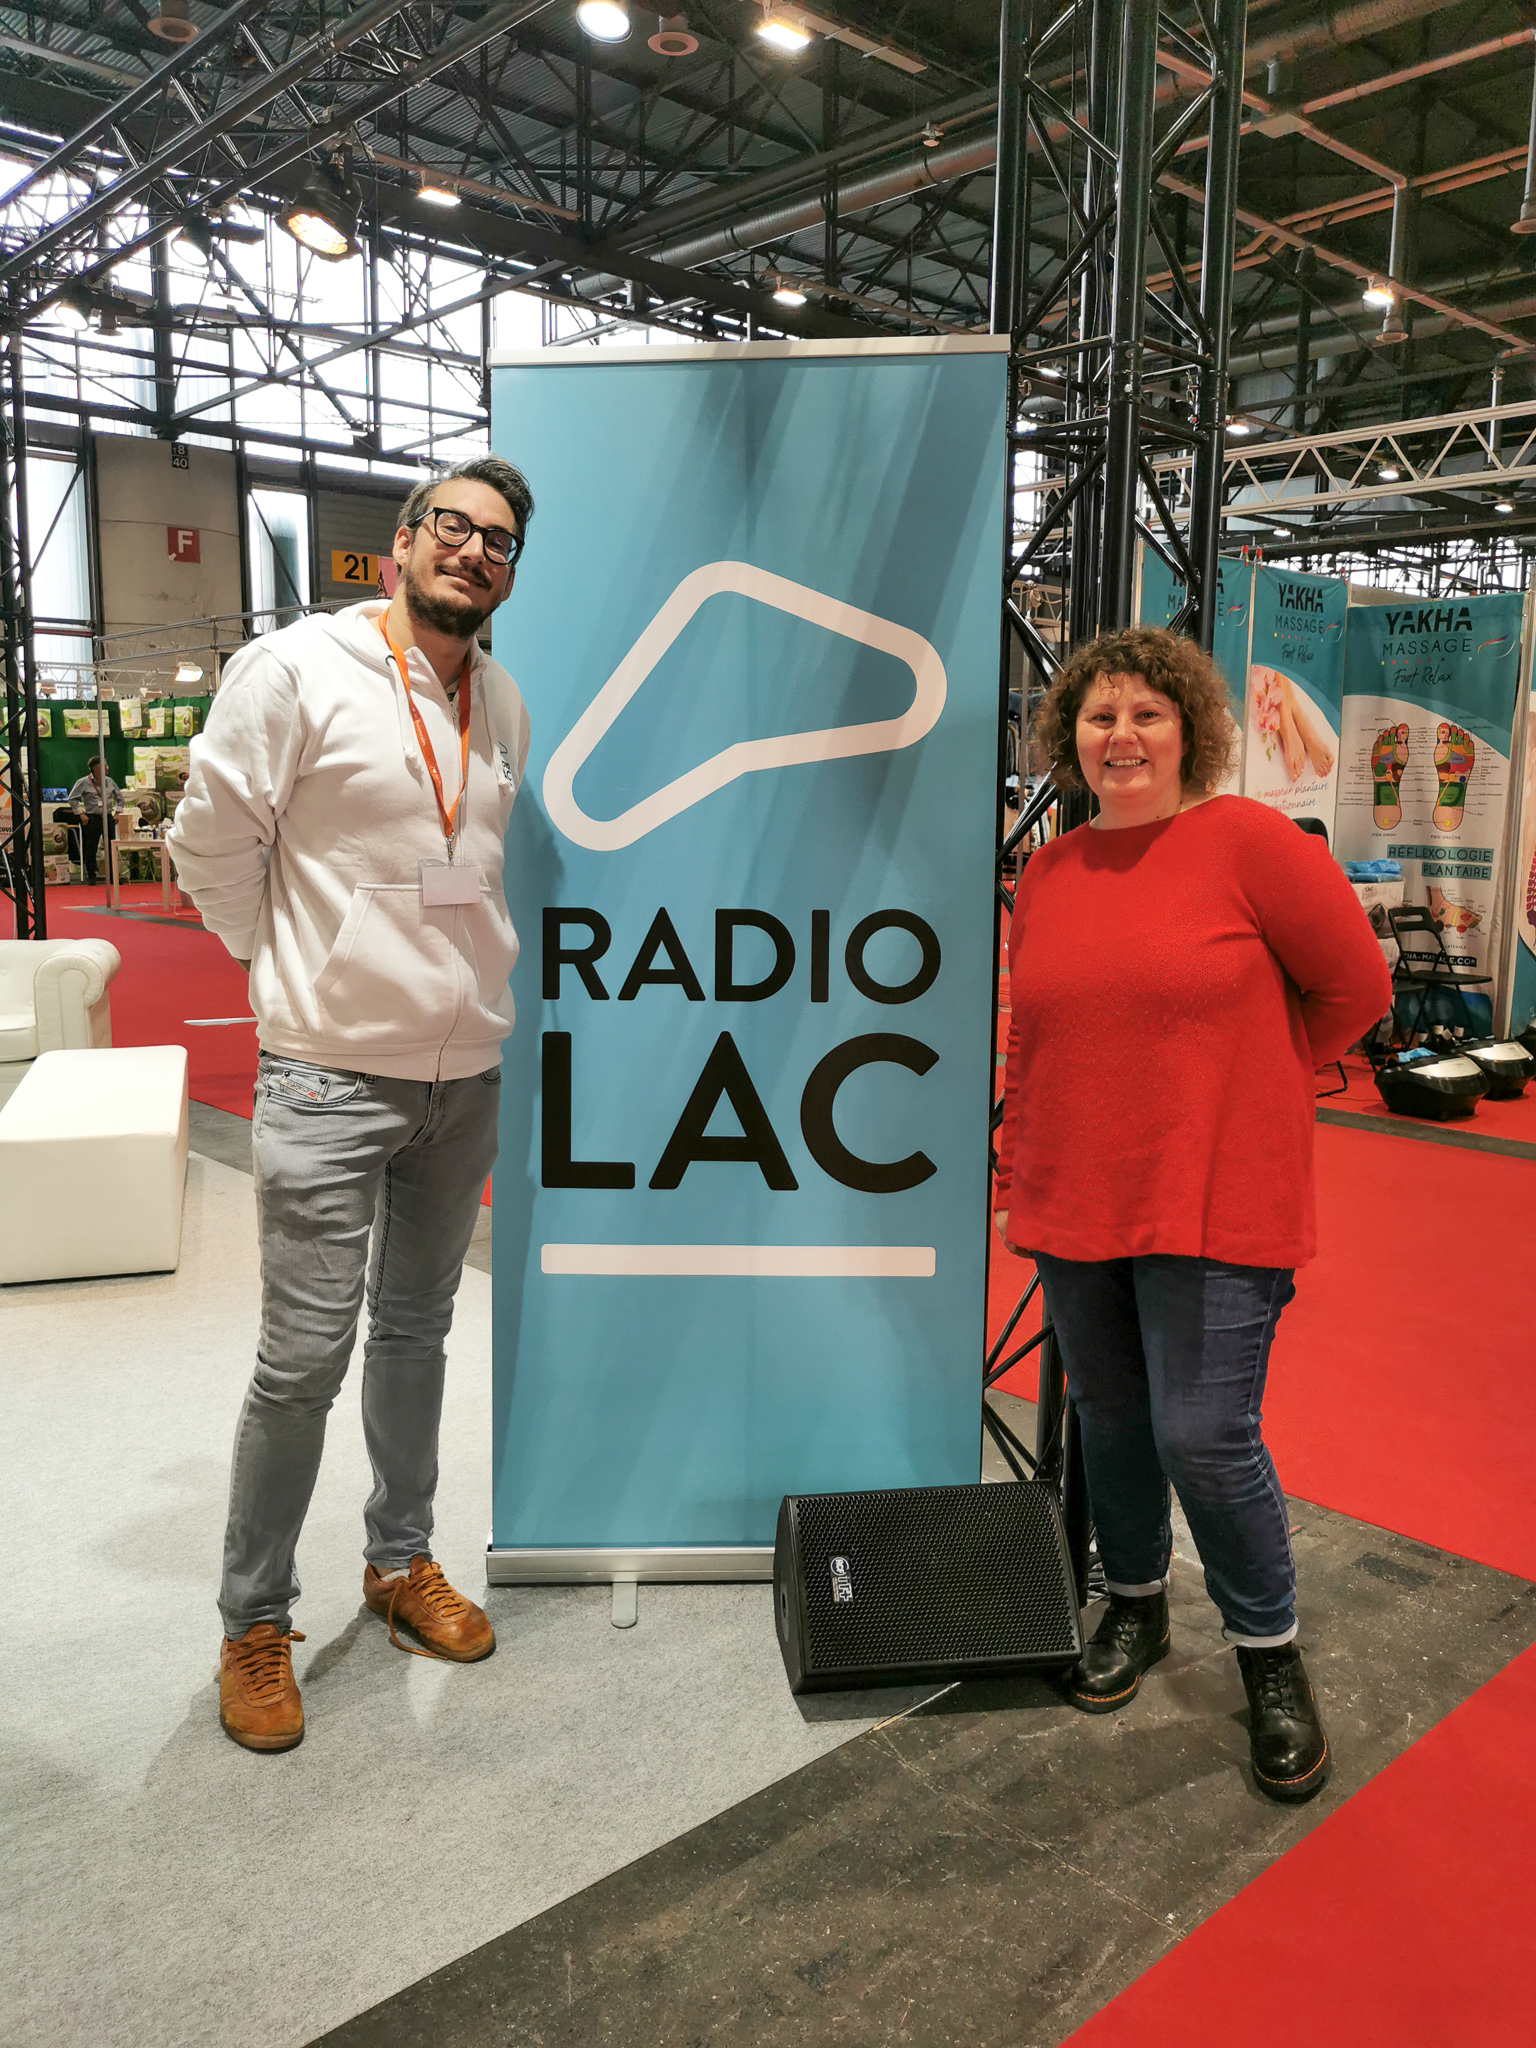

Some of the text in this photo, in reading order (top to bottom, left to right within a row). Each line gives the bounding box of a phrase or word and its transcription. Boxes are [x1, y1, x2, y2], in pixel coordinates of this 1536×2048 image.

[173, 457, 188, 468] 40
[177, 530, 194, 554] F
[343, 554, 369, 581] 21
[1278, 582, 1324, 613] YAKHA
[1274, 614, 1325, 634] MASSAGE
[1385, 606, 1473, 636] YAKHA
[1382, 638, 1473, 656] MASSAGE
[1393, 665, 1453, 687] Foot Relax
[1294, 781, 1328, 797] plantaire
[1388, 844, 1492, 862] RÉFLEXOLOGIE
[1423, 863, 1491, 879] PLANTAIRE
[542, 906, 942, 1005] RADIO
[541, 1030, 940, 1194] LAC
